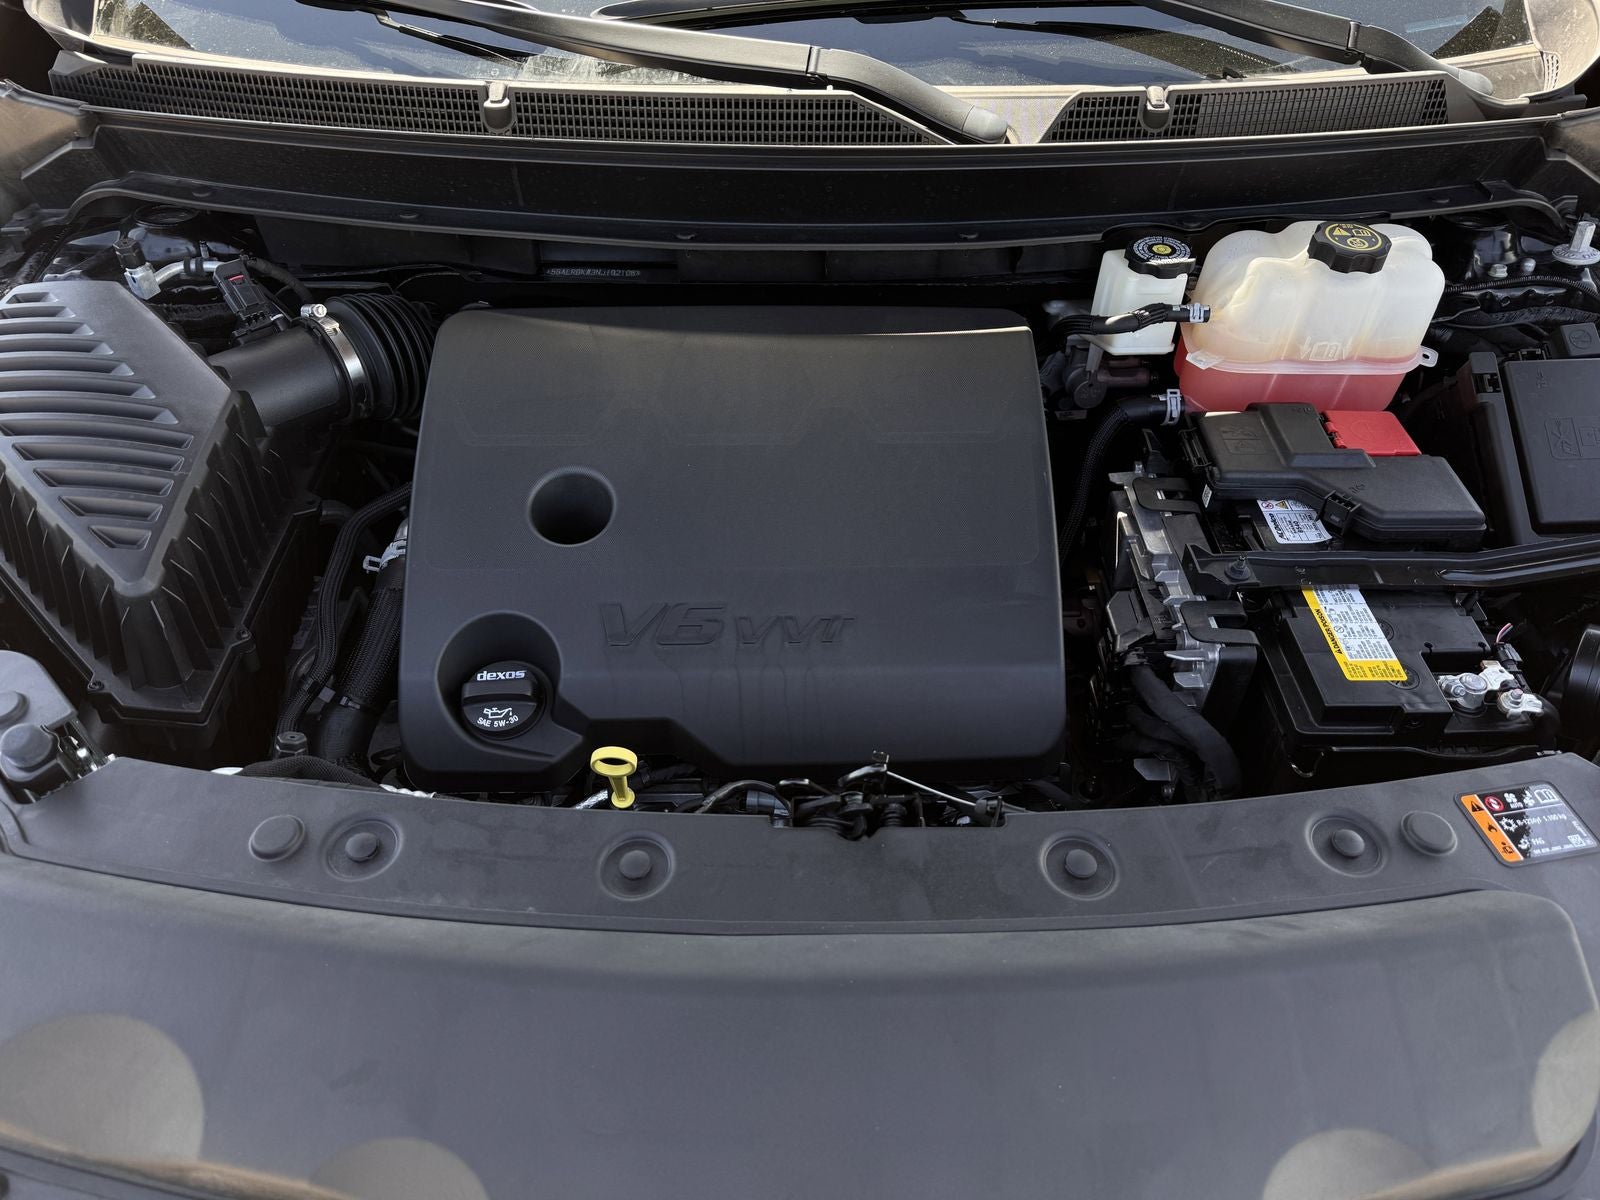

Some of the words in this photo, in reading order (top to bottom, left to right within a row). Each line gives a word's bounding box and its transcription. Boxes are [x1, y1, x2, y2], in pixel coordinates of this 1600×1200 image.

[599, 601, 727, 647] V6
[734, 615, 858, 648] VVT
[477, 670, 527, 681] dexos
[477, 717, 491, 727] SAE
[493, 715, 519, 727] 5W-30
